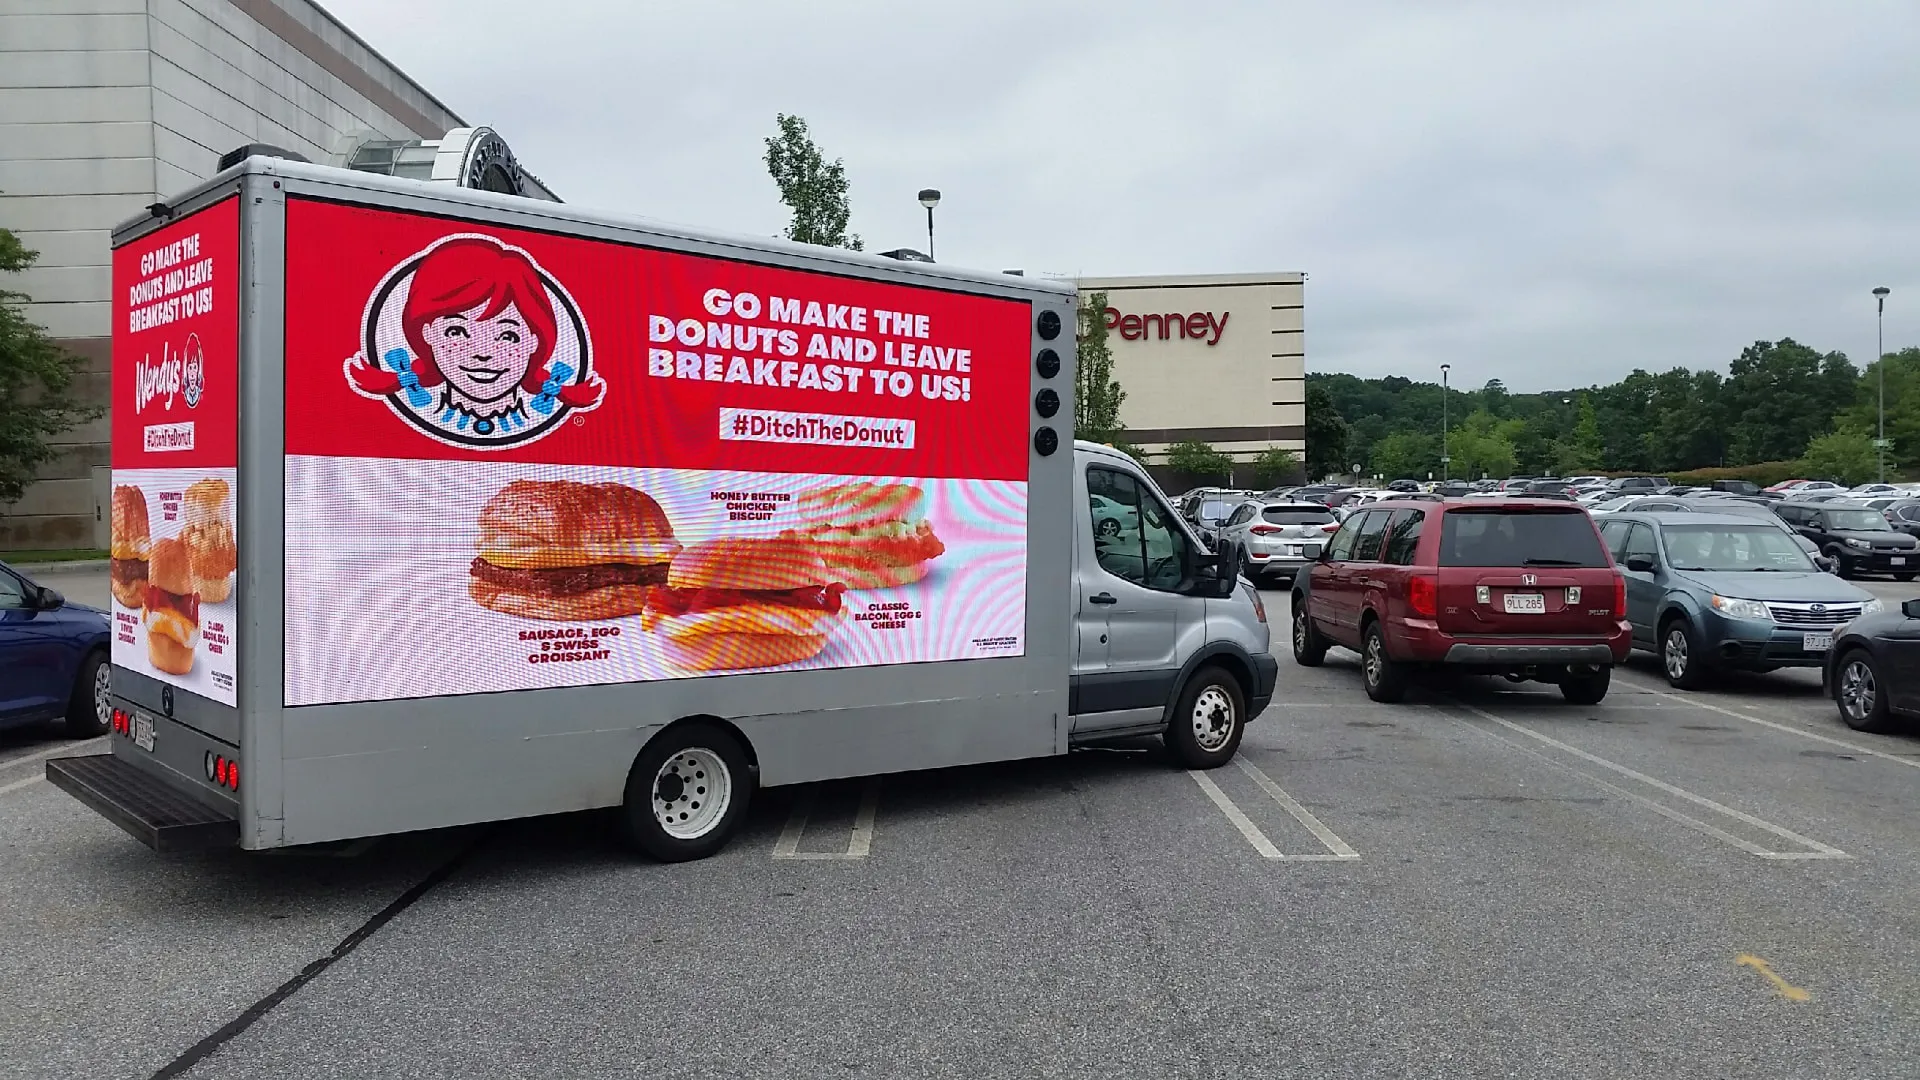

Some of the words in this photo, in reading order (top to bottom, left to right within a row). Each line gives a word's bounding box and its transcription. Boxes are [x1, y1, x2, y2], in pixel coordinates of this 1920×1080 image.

[141, 251, 155, 277] GO
[155, 241, 181, 271] MAKE
[182, 233, 200, 261] THE
[130, 275, 163, 307] DONUTS
[164, 268, 184, 296] AND
[184, 257, 213, 289] LEAVE
[130, 297, 180, 333] BREAKFAST
[181, 292, 195, 319] TO
[196, 286, 213, 315] US!
[703, 288, 761, 319] GO
[769, 296, 867, 332] MAKE
[873, 309, 930, 339] THE
[1078, 306, 1229, 346] Penney
[648, 314, 799, 357] DONUTS
[805, 333, 877, 363] AND
[884, 341, 972, 373] LEAVE
[135, 341, 181, 415] Wendy's
[648, 347, 864, 393] BREAKFAST
[869, 369, 914, 398] TO
[920, 373, 971, 402] US!
[732, 414, 905, 444] #DitchTheDonut
[710, 491, 749, 501] HONEY
[751, 493, 791, 502] BUTTER
[726, 502, 776, 511] CHICKEN
[729, 511, 773, 521] BISCUIT
[868, 602, 910, 612] CLASSIC
[1506, 599, 1524, 609] 9LL
[1525, 599, 1543, 609] 285
[854, 612, 893, 622] BACON,
[894, 611, 914, 620] EGG
[871, 620, 906, 630] CHEESE
[518, 628, 589, 641] SAUSAGE,
[591, 626, 621, 638] EGG
[541, 641, 551, 651] &
[553, 639, 599, 651] SWISS
[528, 649, 611, 664] CROISSANT
